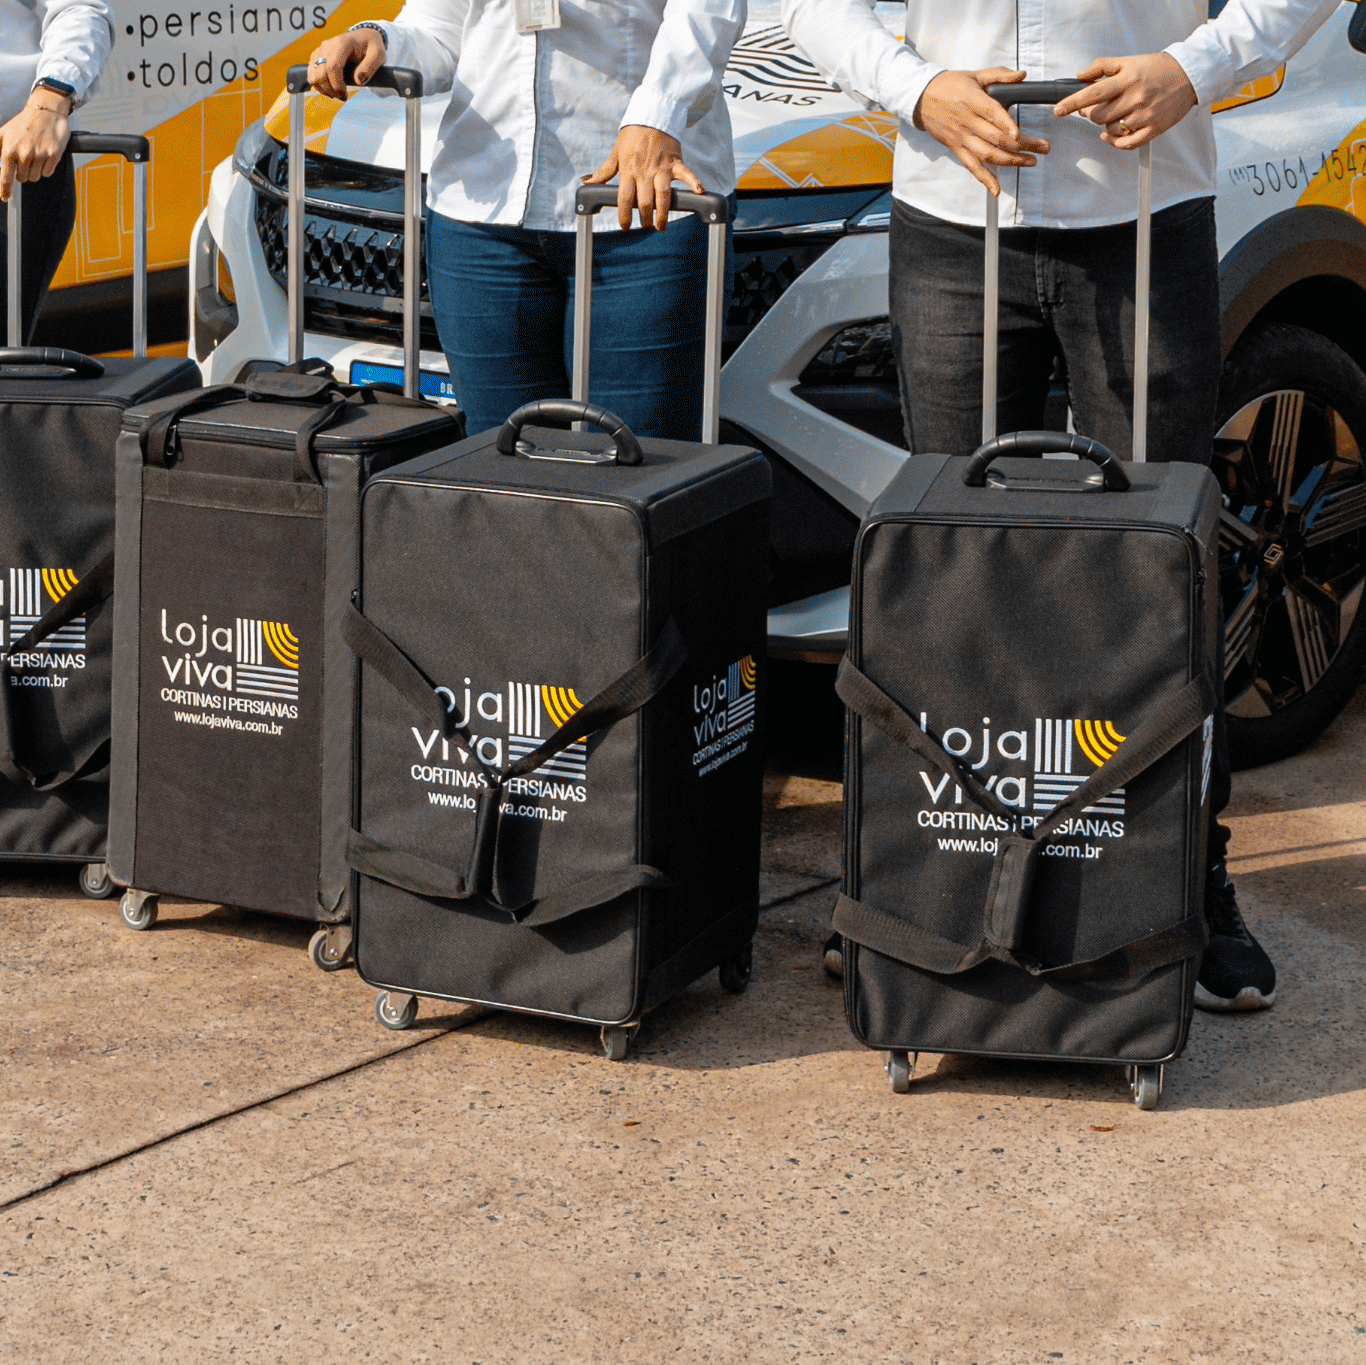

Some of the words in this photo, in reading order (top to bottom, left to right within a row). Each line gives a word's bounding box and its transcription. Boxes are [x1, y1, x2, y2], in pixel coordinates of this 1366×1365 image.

[139, 3, 328, 46] persianas
[139, 52, 260, 88] toldos
[161, 608, 233, 658] loja
[161, 652, 233, 691] viva
[161, 687, 222, 709] CORTINAS
[228, 697, 299, 719] PERSIANAS
[434, 677, 503, 729] oja
[693, 674, 727, 714] loja
[174, 710, 284, 736] www.lojaviva.com.br
[694, 710, 727, 746] viva
[411, 765, 488, 789] CORTINAS
[499, 775, 587, 802] ERSIANAS
[917, 810, 1010, 832] CORTINAS
[1021, 815, 1125, 838] PESIANAS
